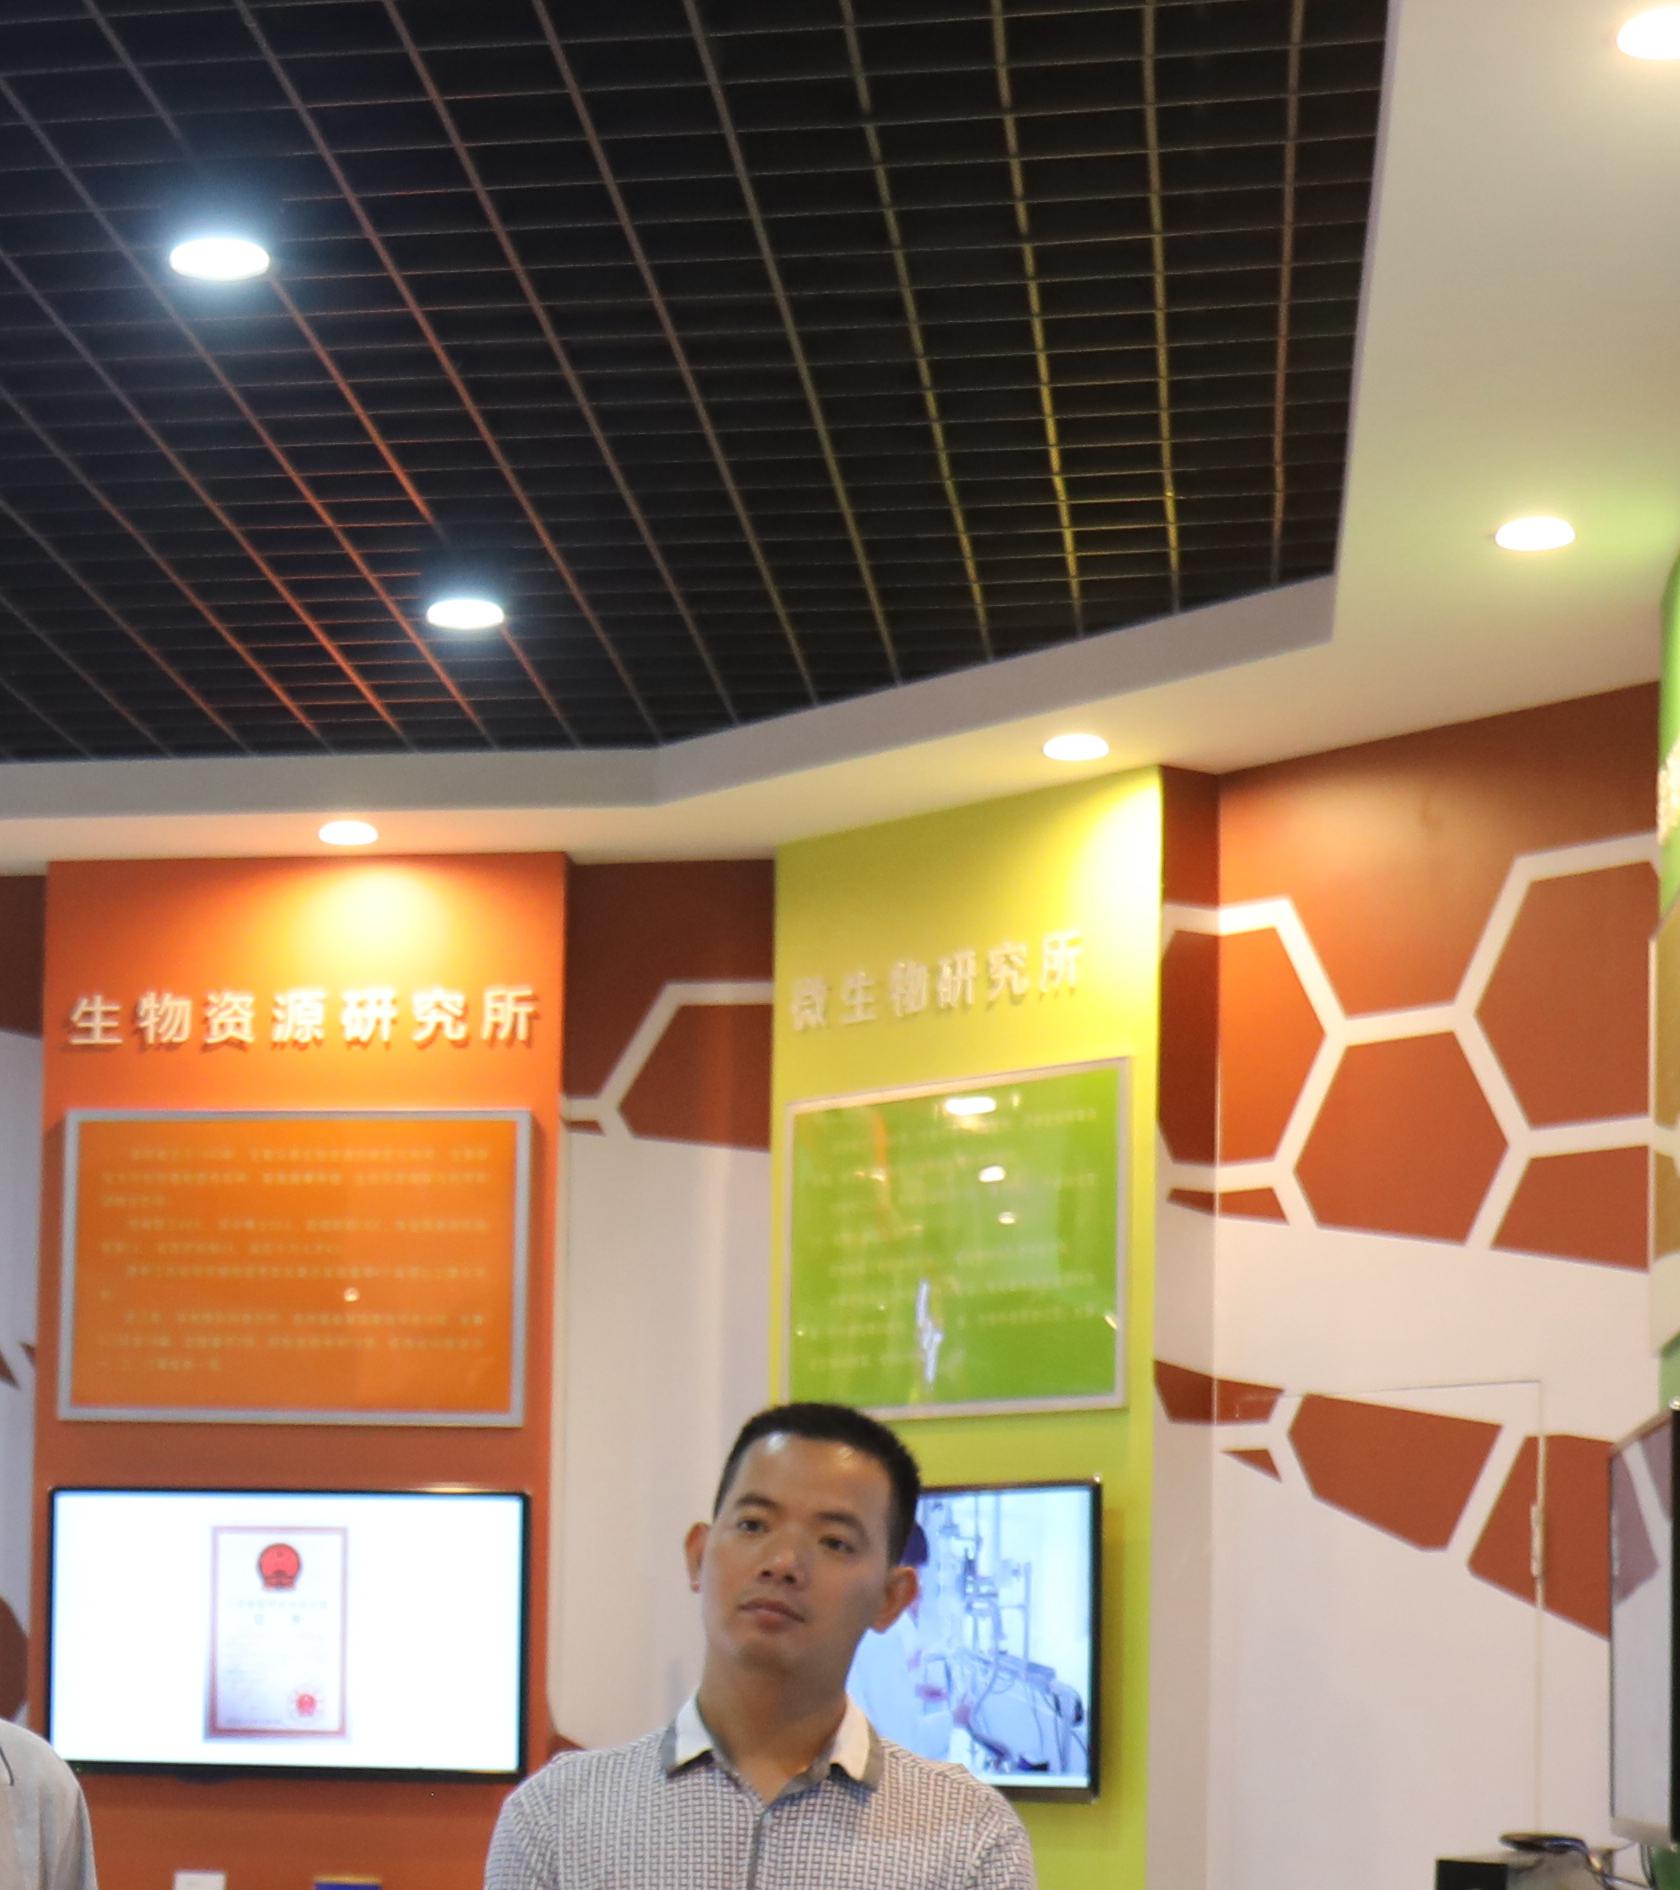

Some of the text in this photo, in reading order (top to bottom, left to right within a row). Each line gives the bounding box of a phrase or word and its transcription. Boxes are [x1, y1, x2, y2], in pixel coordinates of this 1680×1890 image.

[69, 985, 537, 1047] 生物资源研究所
[789, 930, 1083, 1031] 微生物研究所
